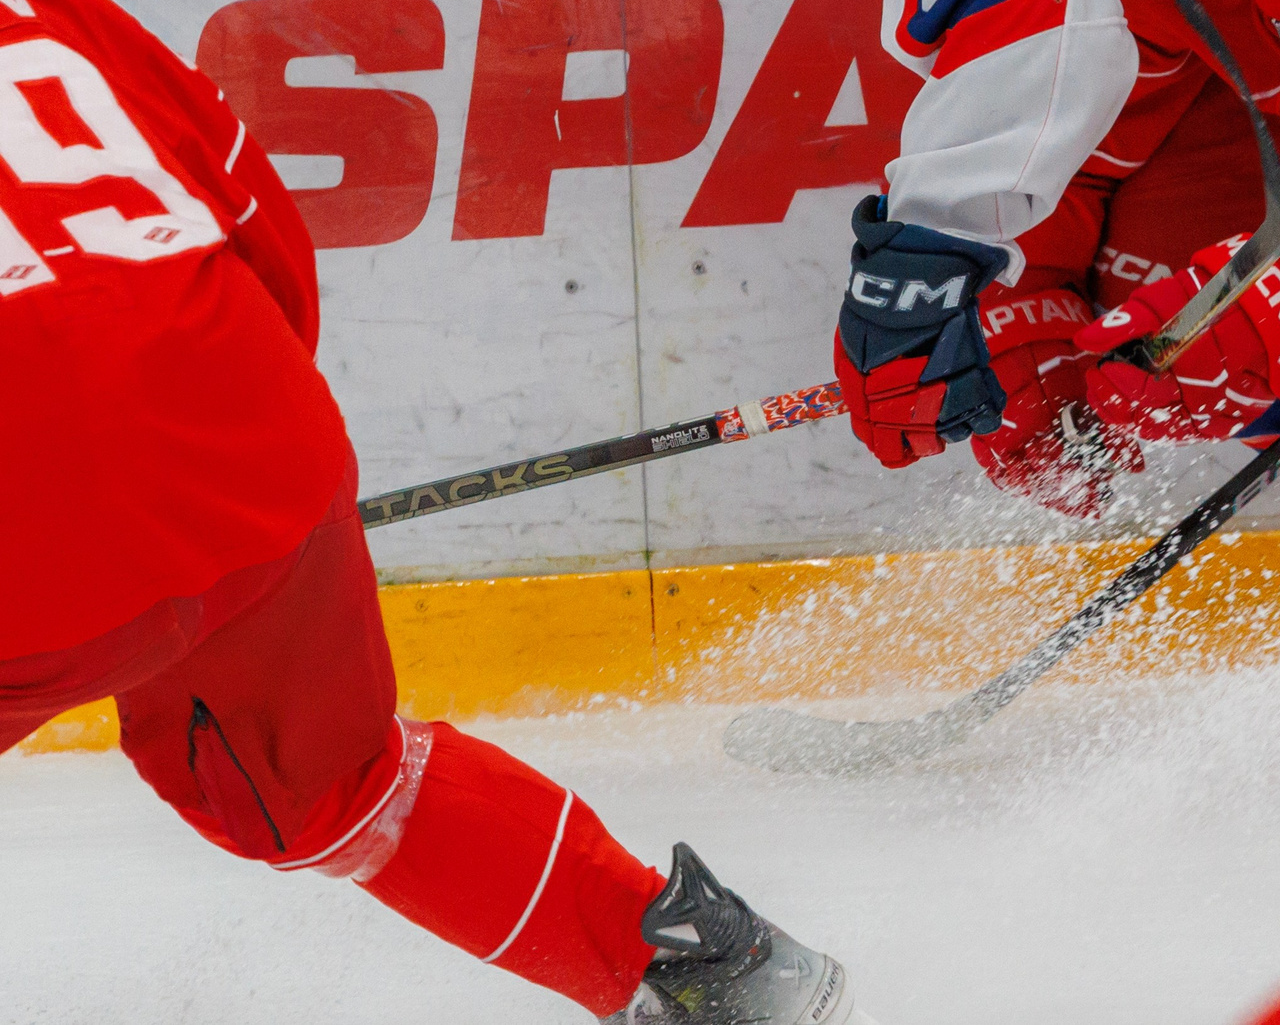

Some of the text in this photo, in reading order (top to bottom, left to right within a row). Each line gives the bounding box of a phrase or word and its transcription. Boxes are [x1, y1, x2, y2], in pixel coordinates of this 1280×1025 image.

[0, 37, 228, 297] 9
[846, 270, 971, 313] CM
[651, 425, 707, 443] NANOLITE
[366, 454, 575, 520] TACKS
